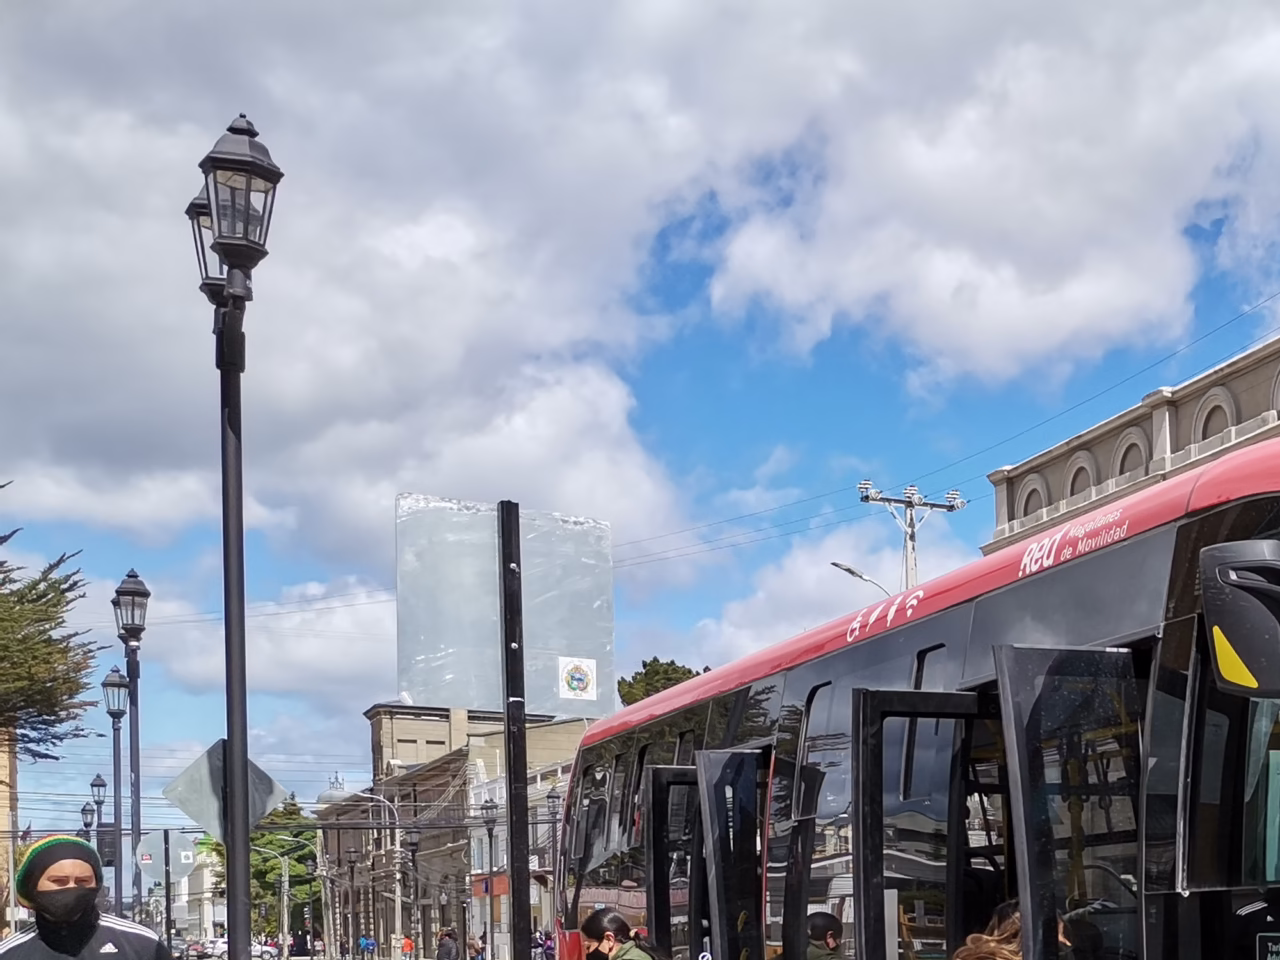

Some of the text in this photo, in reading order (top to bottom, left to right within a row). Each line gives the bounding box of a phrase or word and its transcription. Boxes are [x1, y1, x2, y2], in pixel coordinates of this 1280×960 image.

[1060, 520, 1129, 561] de Movilidad
[1066, 509, 1123, 540] Magallanes
[1018, 523, 1071, 578] Red
